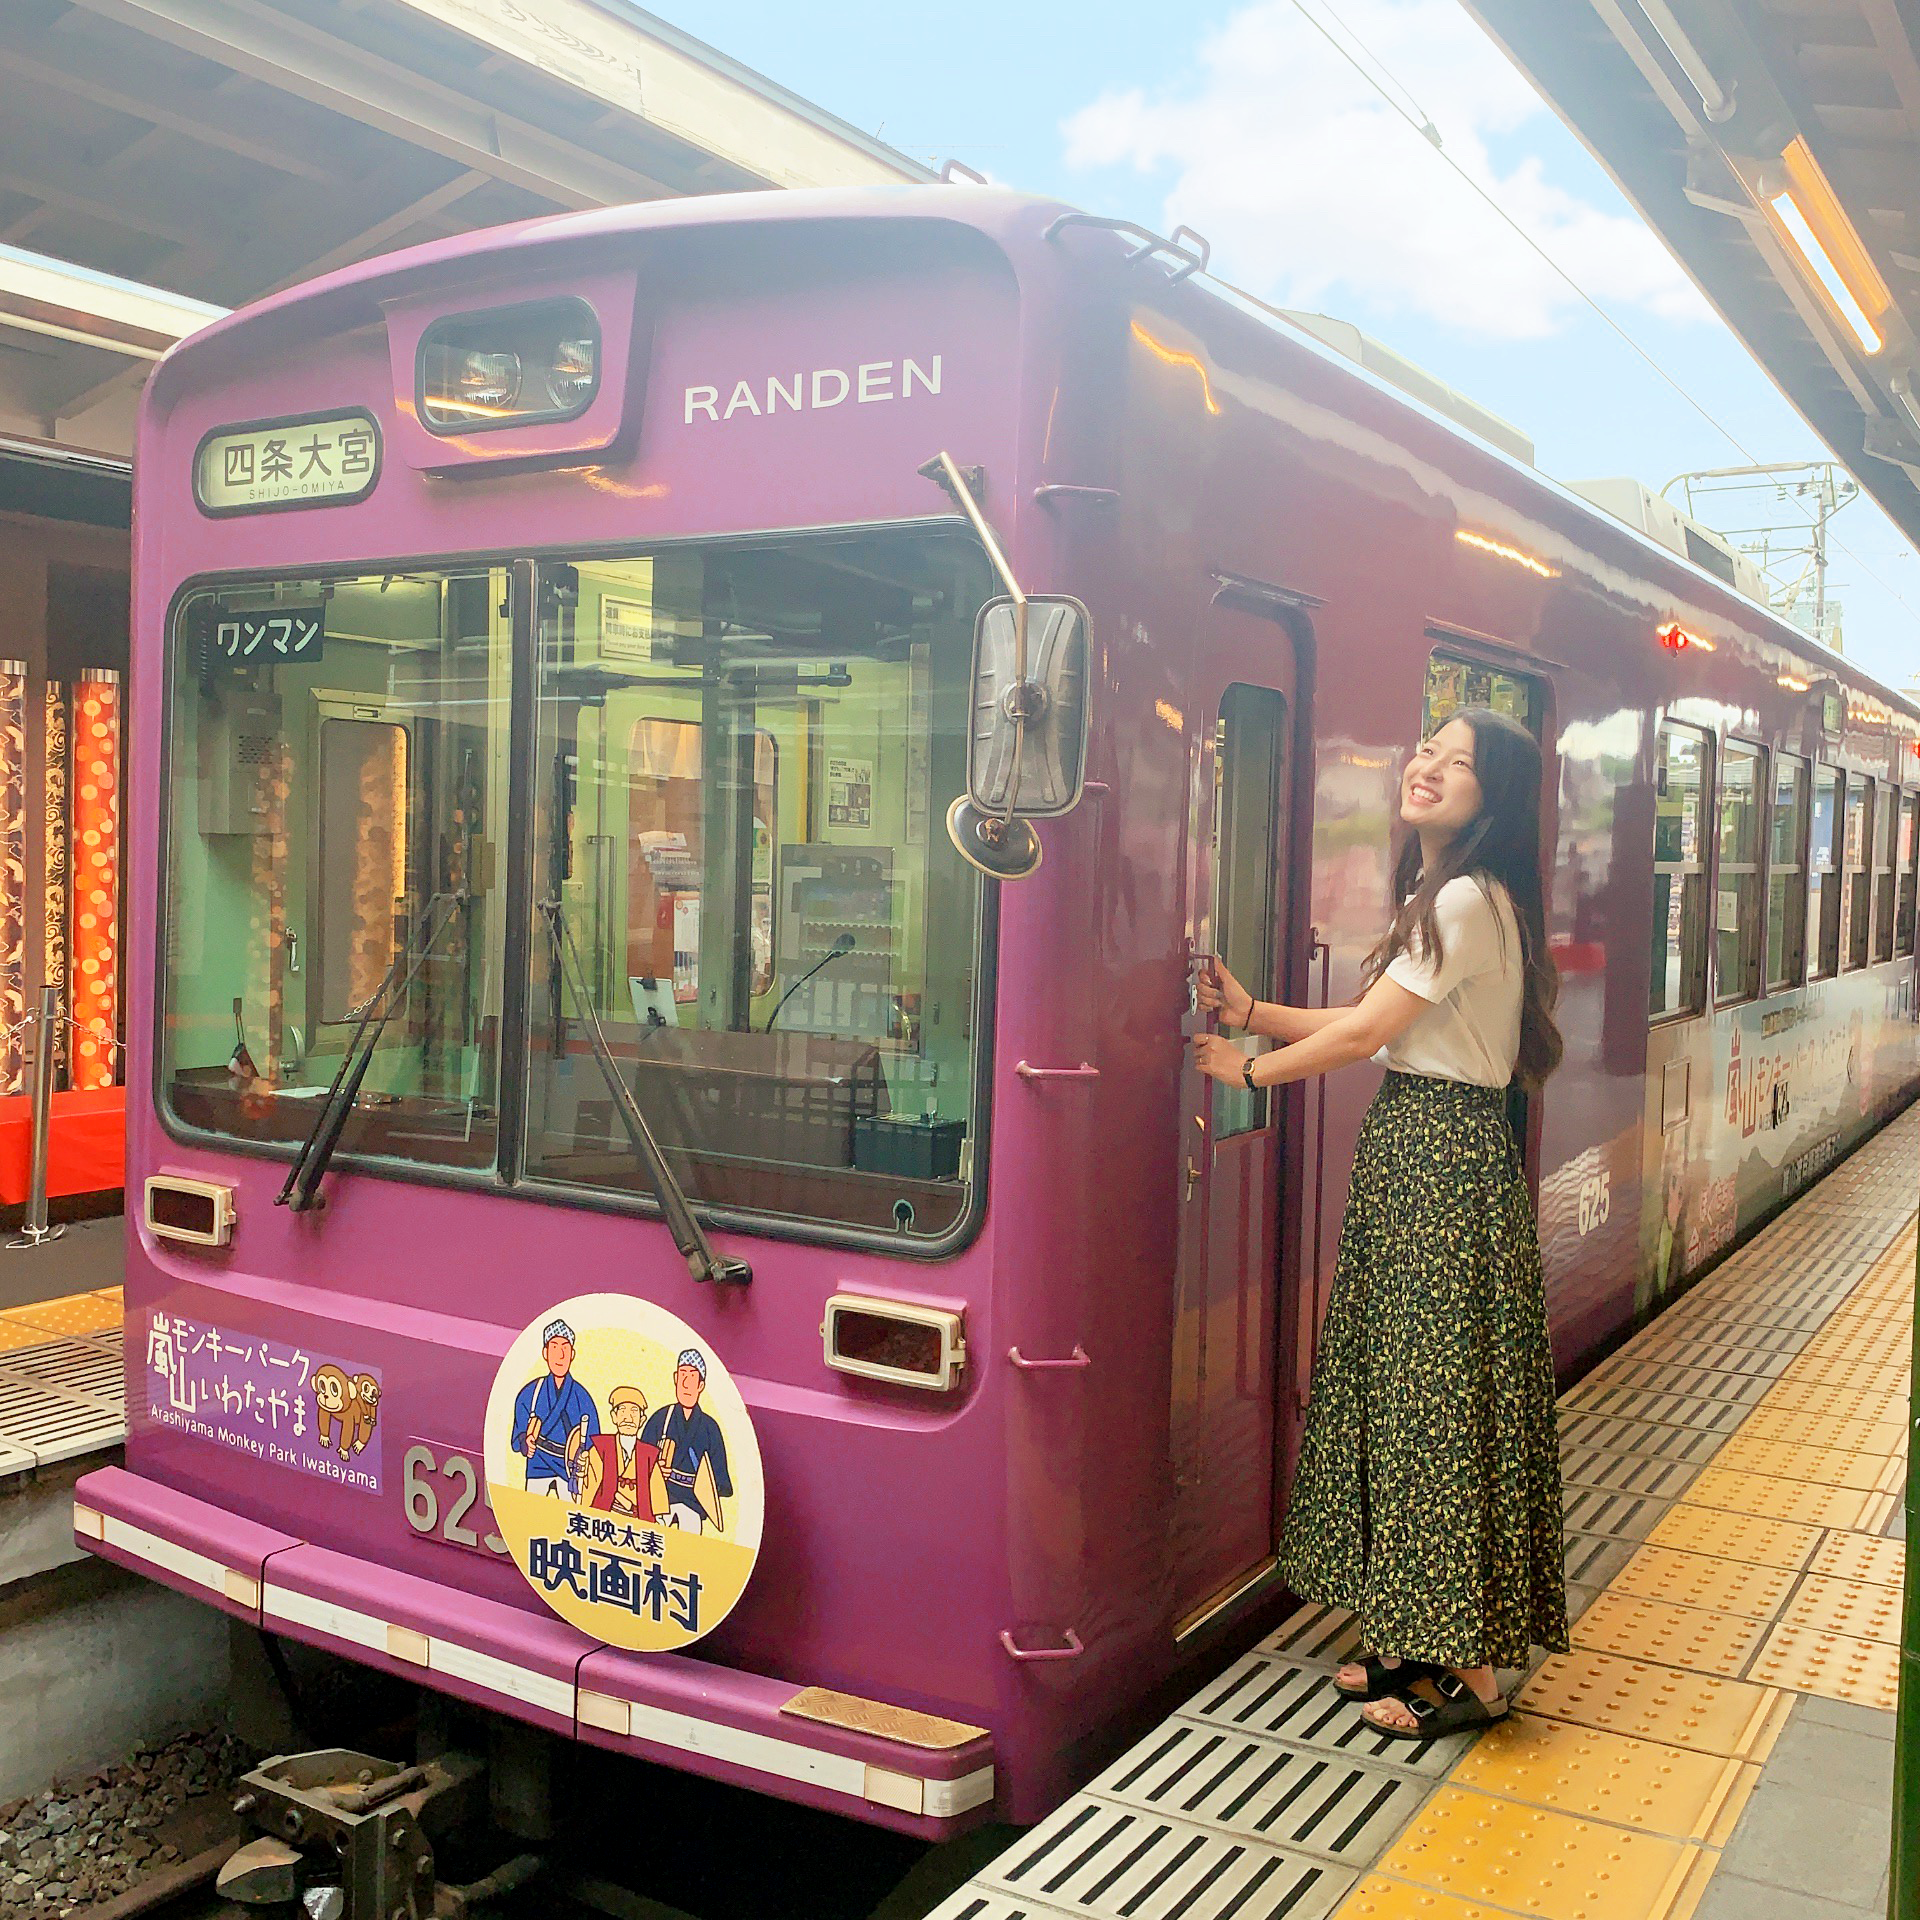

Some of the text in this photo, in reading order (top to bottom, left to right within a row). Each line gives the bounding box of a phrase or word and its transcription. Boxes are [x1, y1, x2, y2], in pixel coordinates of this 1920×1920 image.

[684, 354, 942, 424] RANDEN
[224, 428, 374, 487] 四条大宮
[249, 480, 345, 500] SHIJO-OMIYA
[217, 618, 319, 657] ワンマン
[1578, 1171, 1610, 1237] 625
[147, 1311, 196, 1414] 嵐山
[172, 1318, 310, 1387] モンキーパーク
[201, 1374, 307, 1437] いわたやま
[151, 1404, 378, 1490] Arashiyama Monkey Park Iwatayama
[566, 1511, 665, 1558] 東映太秦
[528, 1536, 703, 1634] 映画村
